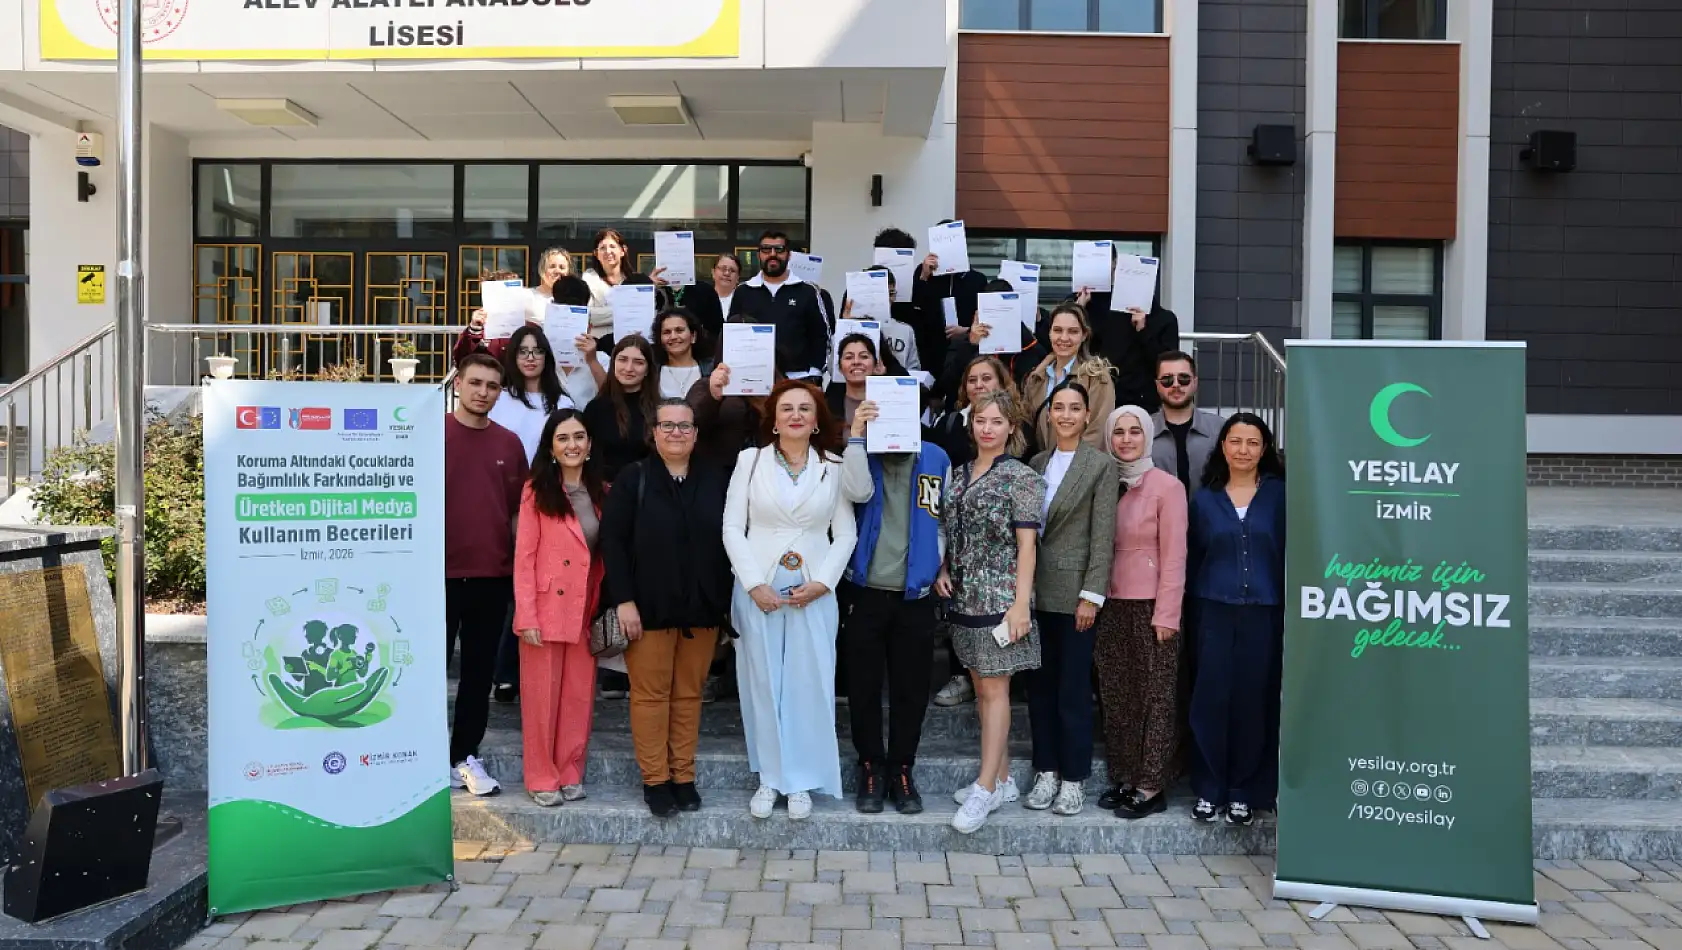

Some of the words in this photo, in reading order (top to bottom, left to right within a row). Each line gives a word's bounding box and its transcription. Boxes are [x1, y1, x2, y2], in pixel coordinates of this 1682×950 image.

[369, 20, 464, 46] LİSESİ
[237, 455, 287, 468] Koruma
[290, 454, 346, 468] Altındaki
[349, 454, 414, 470] Çocuklarda
[237, 472, 310, 489] Bağımlılık
[313, 472, 395, 488] Farkındalığı
[399, 475, 414, 486] ve
[239, 497, 306, 517] Üretken
[310, 498, 358, 518] Dijital
[361, 498, 413, 517] Medya
[1376, 500, 1432, 521] İZMİR
[239, 524, 321, 544] Kullanım
[327, 524, 413, 542] Becerileri
[329, 548, 354, 560] 2026
[1324, 553, 1423, 587] hepimiz
[1432, 559, 1486, 591] için
[1300, 581, 1511, 628] BAĞIMSIZ
[1351, 619, 1462, 658] gelecek...
[1348, 755, 1457, 778] yesilay.org.tr
[1348, 803, 1456, 830] /1920yesilay
